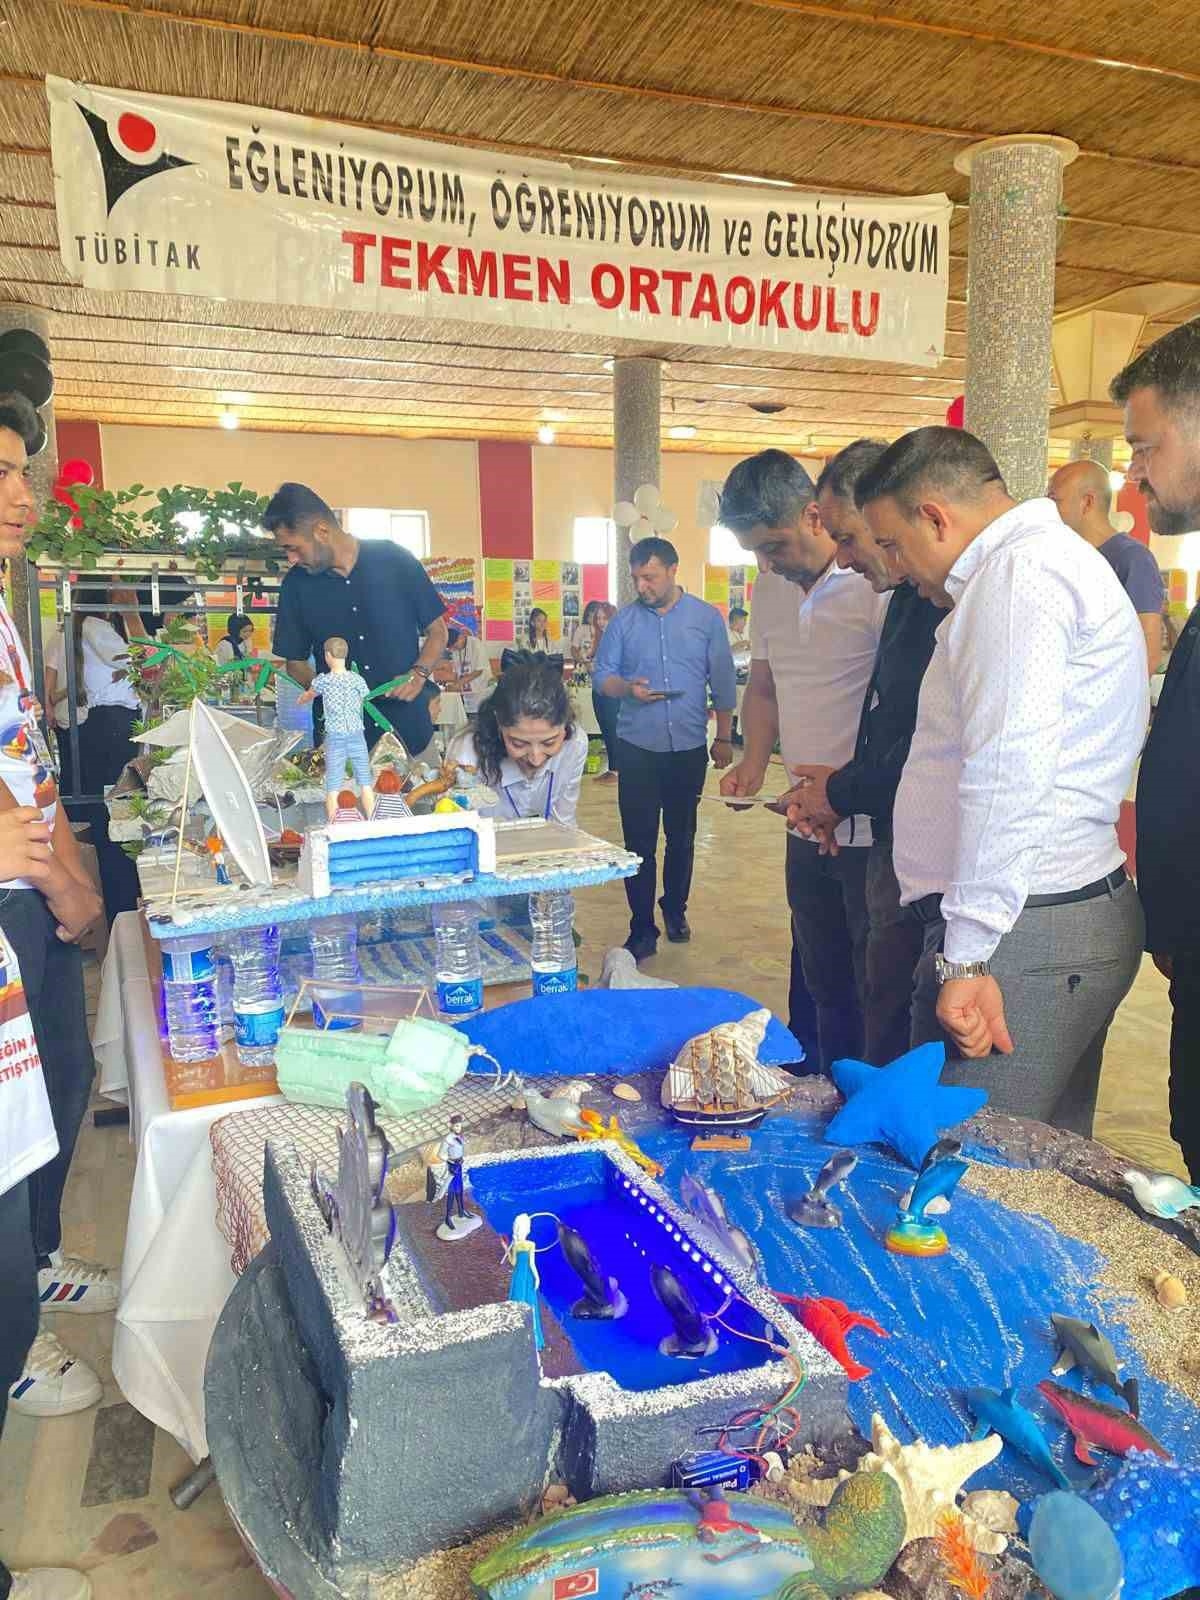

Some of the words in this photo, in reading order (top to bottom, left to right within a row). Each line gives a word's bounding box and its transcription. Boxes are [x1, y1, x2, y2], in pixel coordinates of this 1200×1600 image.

[75, 232, 201, 270] TÜBİTAK
[225, 125, 476, 238] EĞLENİYORUM,
[490, 170, 710, 254] ÖĞRENİYORUM
[723, 217, 753, 257] ve
[764, 201, 938, 278] GELİŞİYORUM
[341, 231, 571, 305] TEKMEN
[591, 263, 881, 337] ORTAOKULU
